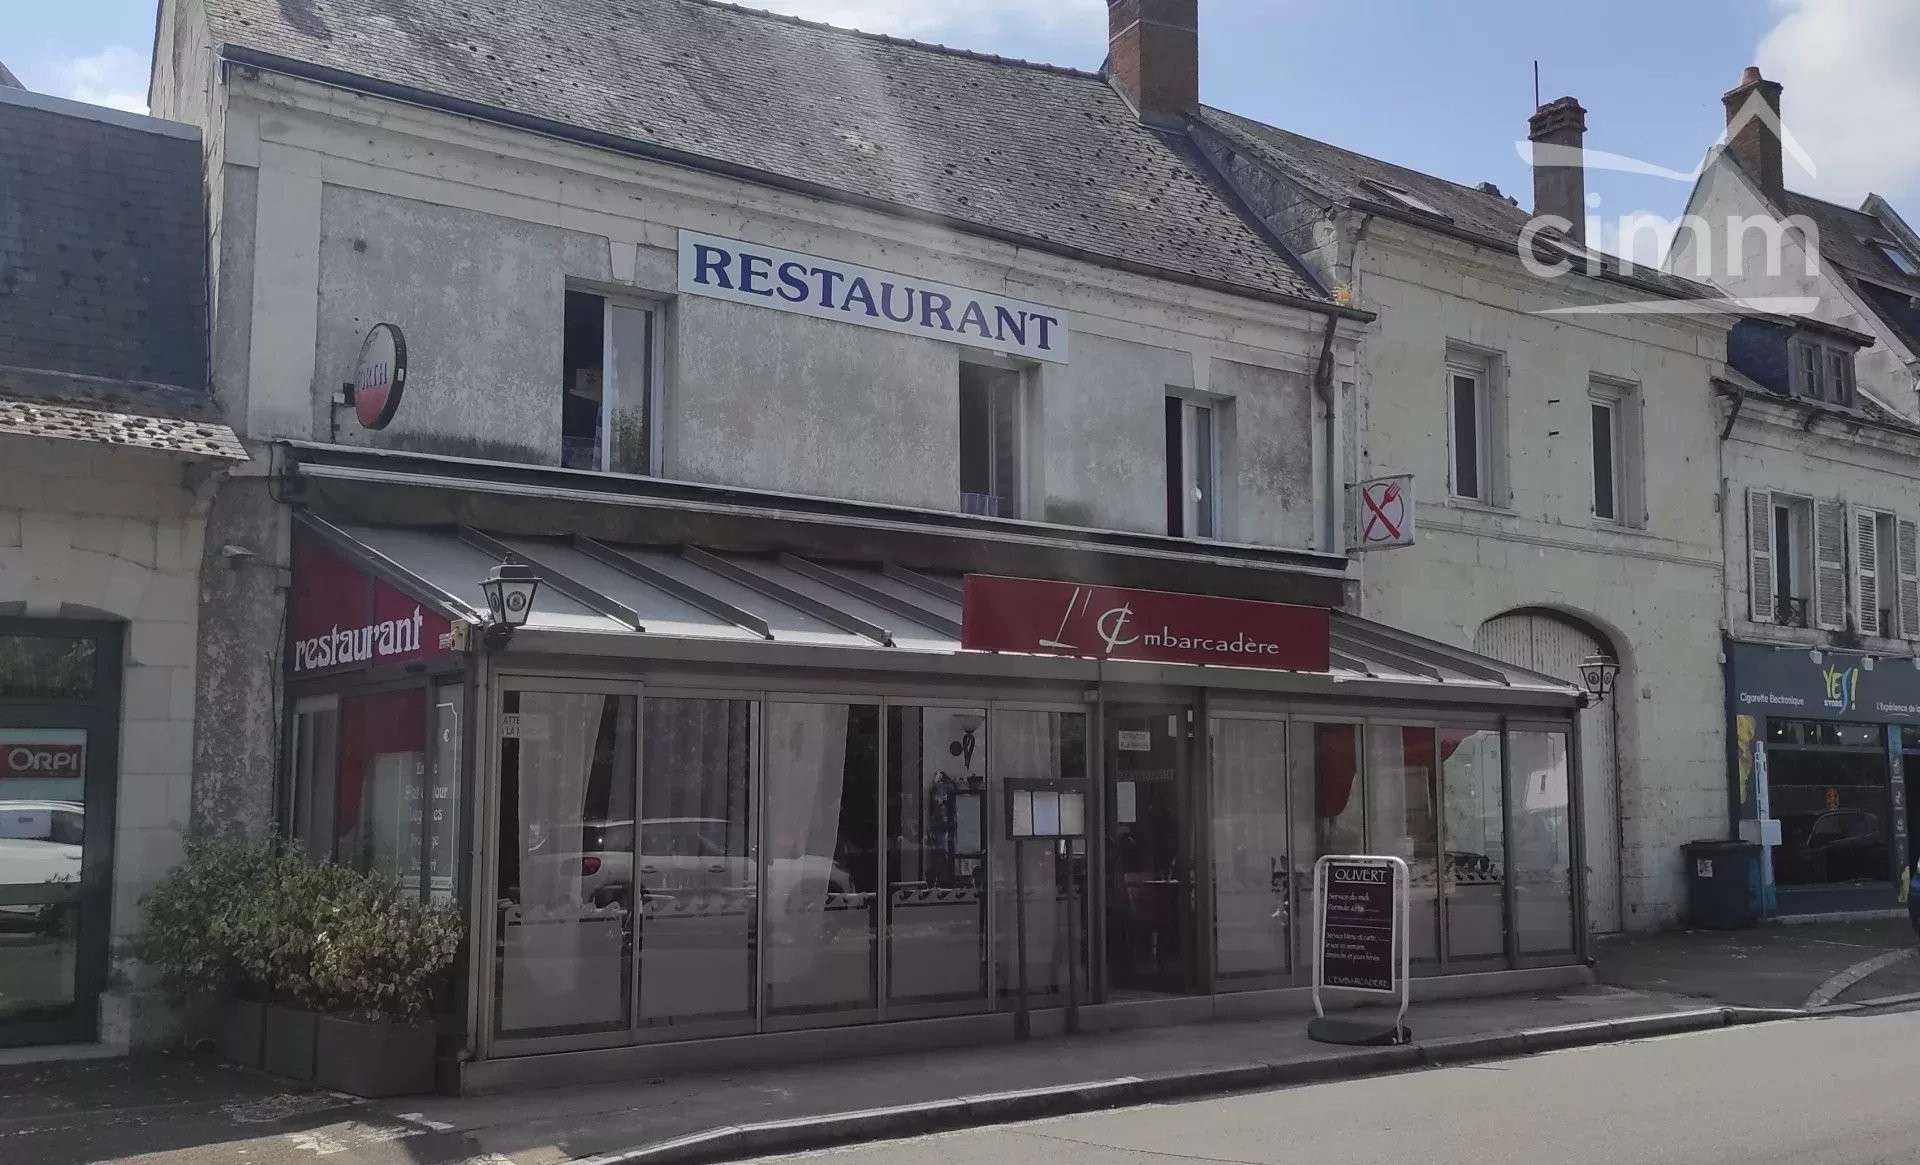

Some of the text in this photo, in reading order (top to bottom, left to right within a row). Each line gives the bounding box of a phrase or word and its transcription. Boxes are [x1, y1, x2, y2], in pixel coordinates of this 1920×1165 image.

[692, 243, 1058, 350] RESTAURANT
[294, 604, 423, 672] restaurant
[1740, 693, 1768, 704] Cigarette
[8, 748, 78, 771] ORPI
[1335, 869, 1387, 882] OUVERT
